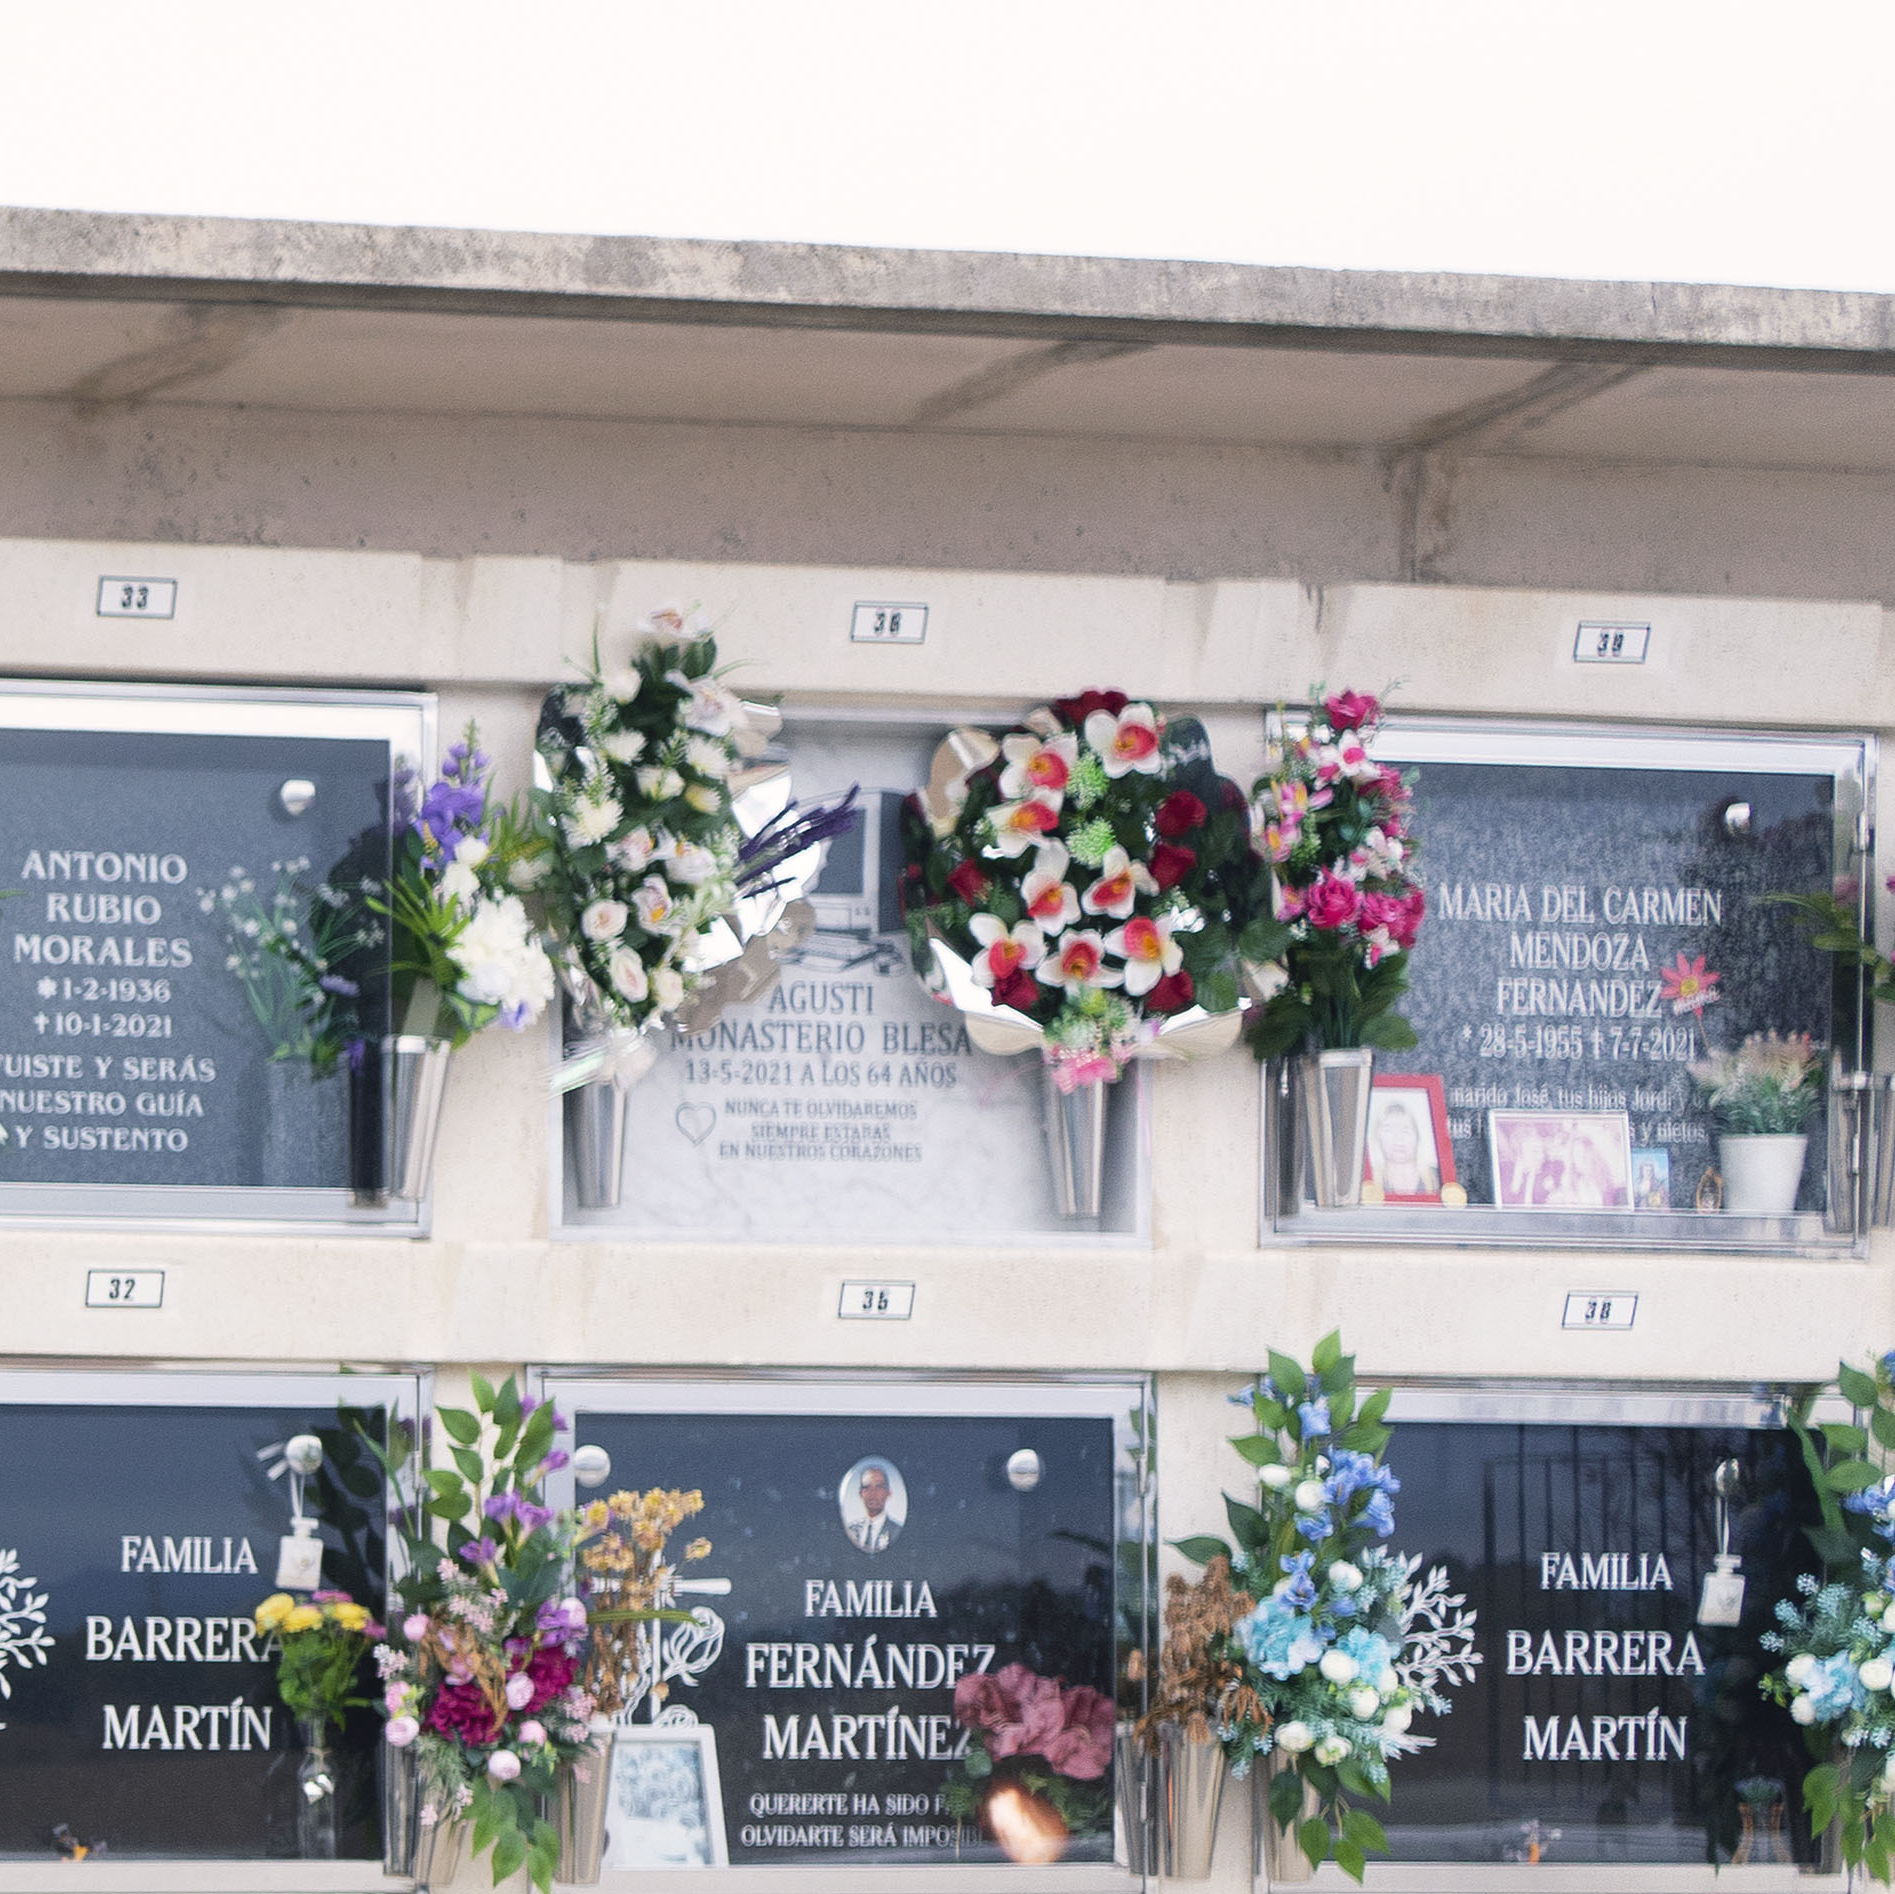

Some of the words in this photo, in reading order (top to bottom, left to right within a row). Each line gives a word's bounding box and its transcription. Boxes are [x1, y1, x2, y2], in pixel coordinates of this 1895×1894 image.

[121, 586, 149, 610] 33
[21, 850, 188, 884] ANTONIO
[47, 892, 162, 925] RUBIO
[1438, 882, 1532, 922] MARIA
[1540, 884, 1595, 924] DEL
[1603, 885, 1722, 926] CARMEN
[14, 934, 193, 968] MORALES
[1510, 931, 1650, 971] MENDOZA
[1497, 976, 1662, 1018] FERNANDEZ
[882, 1021, 973, 1057] BLESA
[96, 1055, 113, 1079] Y
[123, 1053, 216, 1083] SERÁS
[686, 1058, 792, 1085] 13-5-2021
[800, 1063, 814, 1086] A
[822, 1062, 860, 1087] LOS
[867, 1064, 891, 1087] 64
[899, 1058, 958, 1088] AÑOS
[136, 1088, 205, 1118] GUÍA
[724, 1099, 779, 1118] NUNCA
[783, 1100, 801, 1119] TE
[806, 1100, 917, 1120] OLVIDAREMOS
[15, 1125, 33, 1149] Y
[43, 1125, 189, 1152] SUSTENTO
[751, 1123, 818, 1141] SIEMPRE
[719, 1143, 739, 1161] EN
[745, 1144, 825, 1162] NUESTROS
[829, 1145, 922, 1163] CORAZONES
[109, 1278, 136, 1300] 32
[121, 1535, 259, 1574] FAMILIA
[1540, 1552, 1673, 1591] FAMILIA
[805, 1579, 938, 1618] FAMILIA
[1506, 1629, 1707, 1676] BARRERA
[102, 1696, 273, 1751] MARTÍN
[1523, 1706, 1688, 1761] MARTÍN
[750, 1793, 848, 1817] QUERERTE
[853, 1795, 880, 1816] HA
[885, 1794, 929, 1816] SIDO
[741, 1825, 844, 1848] OLVIDARTE
[848, 1821, 897, 1847] SERÁ
